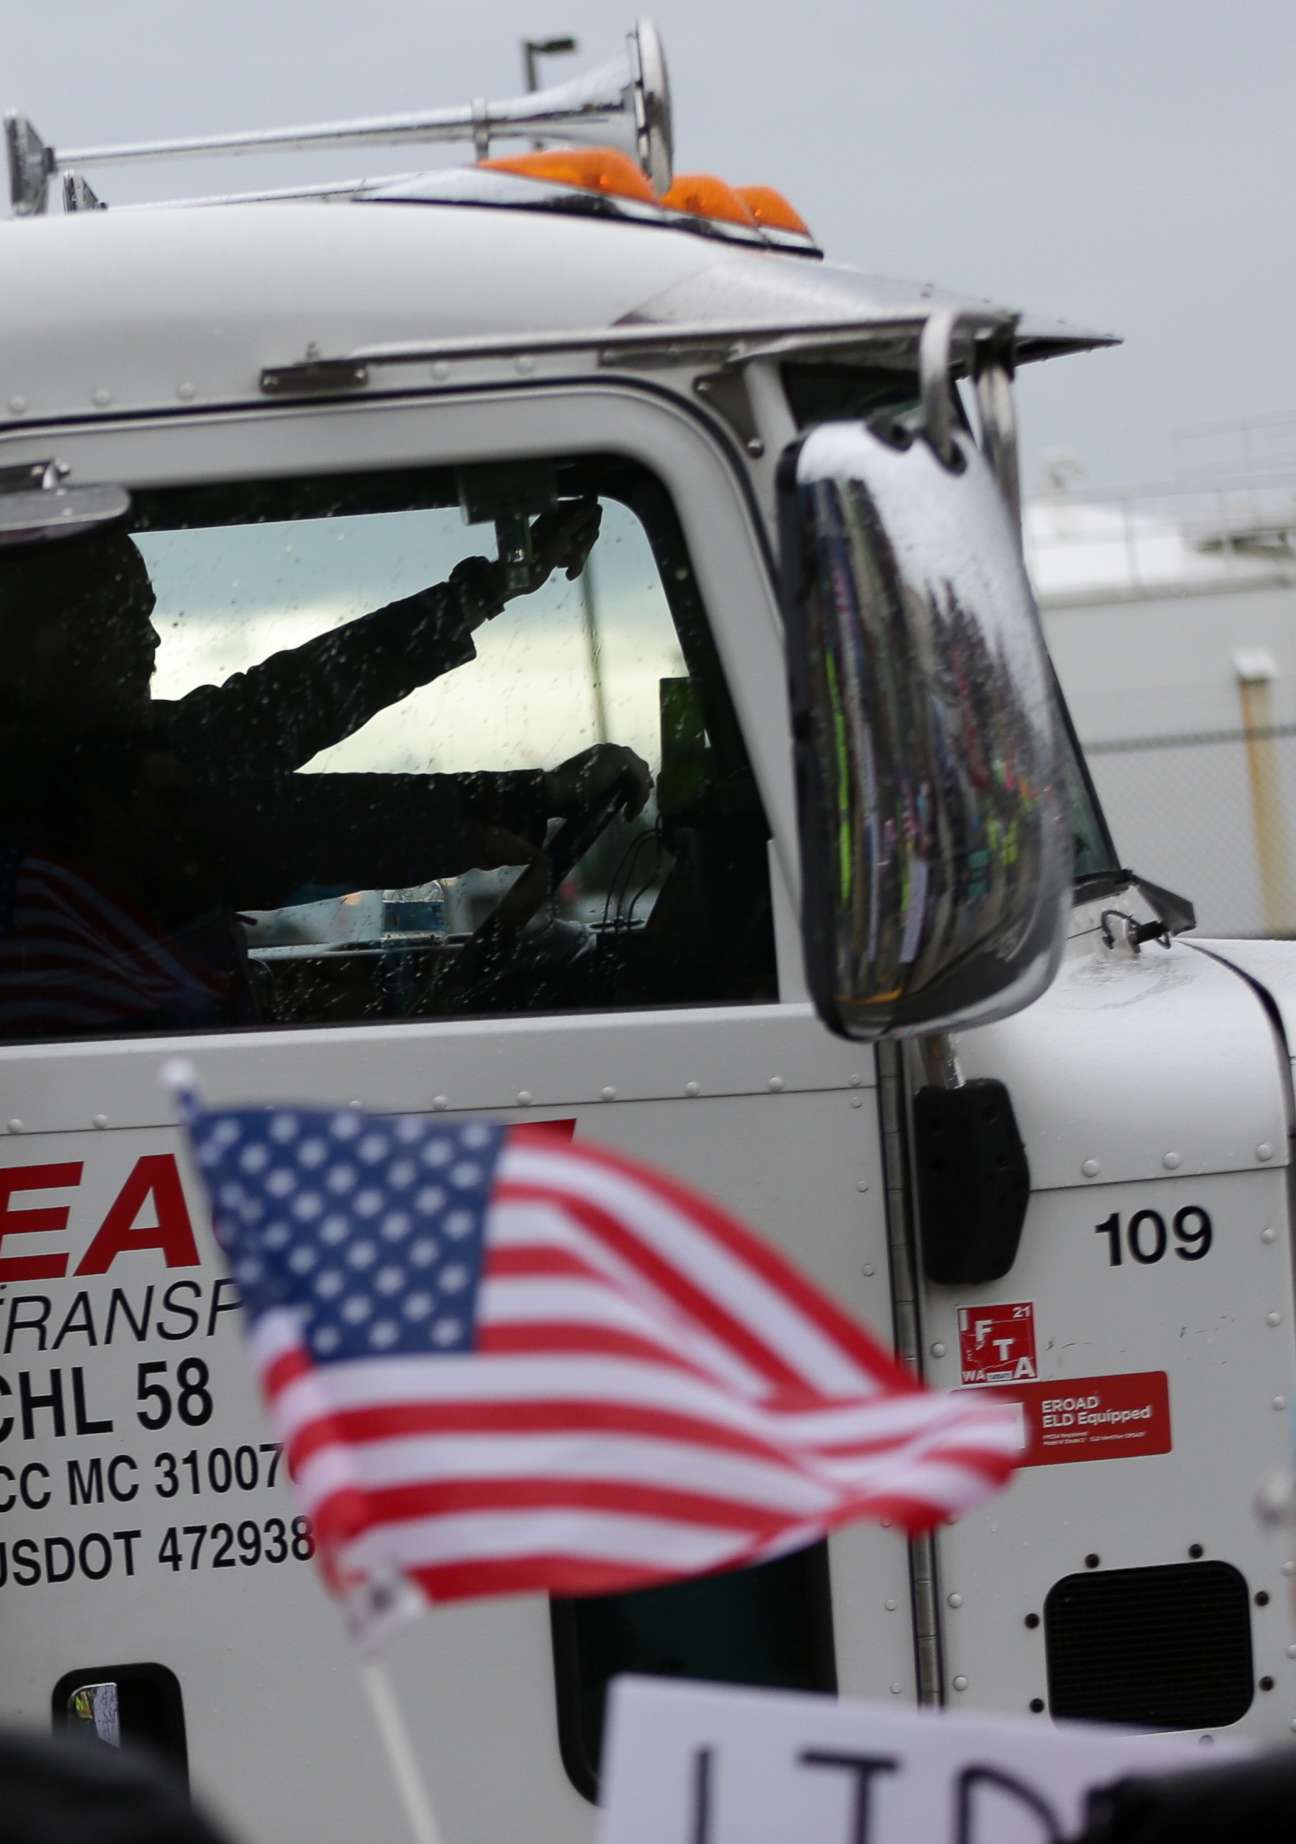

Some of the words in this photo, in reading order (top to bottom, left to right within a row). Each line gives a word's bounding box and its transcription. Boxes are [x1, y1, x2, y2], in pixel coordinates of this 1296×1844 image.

[1095, 1205, 1213, 1267] 109
[1012, 1306, 1031, 1318] 21
[136, 1357, 214, 1431] 58
[962, 1370, 986, 1382] WA
[1041, 1396, 1100, 1414] EROAD
[1042, 1413, 1074, 1428] ELD
[1077, 1404, 1152, 1426] Equipped
[67, 1454, 140, 1506] MC
[154, 1443, 294, 1498] 31007
[158, 1514, 316, 1573] 472938
